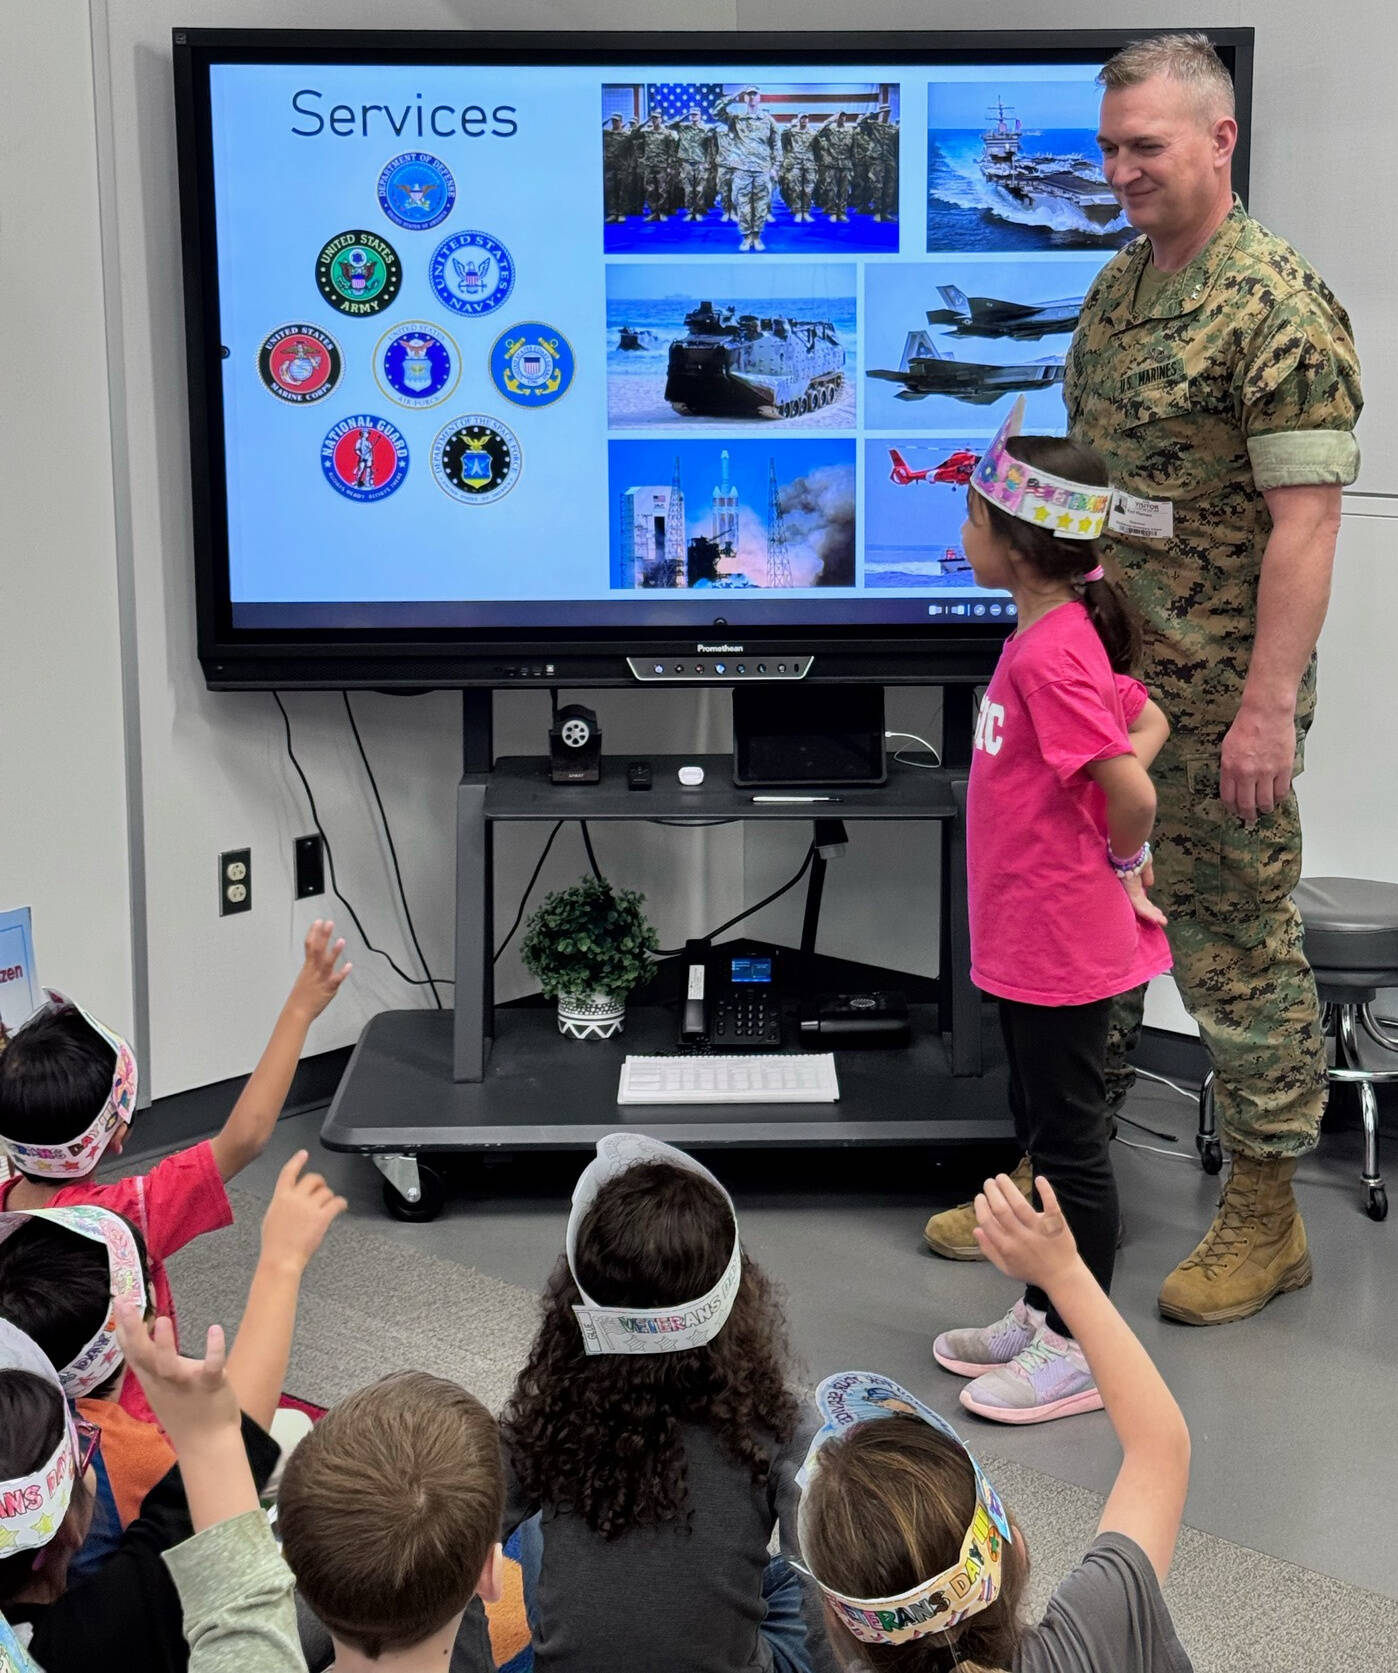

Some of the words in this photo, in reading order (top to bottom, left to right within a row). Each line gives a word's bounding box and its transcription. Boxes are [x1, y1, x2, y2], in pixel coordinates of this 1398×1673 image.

[291, 89, 518, 137] Services
[379, 154, 417, 197] DEPARTMENT
[420, 154, 433, 162] OF
[433, 159, 456, 198] DEFENSE
[320, 234, 355, 263] UNITED
[360, 234, 395, 264] STATES
[434, 235, 471, 289] UNITED
[474, 236, 509, 289] STATES
[340, 300, 380, 313] ARMY
[449, 297, 495, 312] NAVY
[265, 327, 298, 350] UNITED
[302, 326, 334, 350] STATES
[388, 325, 418, 341] UNITED
[420, 325, 445, 341] STATES
[1138, 361, 1178, 386] MARINES
[270, 382, 303, 401] MARINE
[306, 382, 332, 401] CORPS
[322, 416, 374, 457] NATIONAL
[376, 419, 408, 458] GUARD
[433, 422, 460, 474] DEPARTMENT
[491, 421, 513, 442] SPACE
[1135, 501, 1159, 511] VISITOR
[697, 644, 744, 652] Promethean
[68, 1124, 99, 1157] DAY
[618, 1295, 721, 1334] VETERANS
[583, 1320, 598, 1341] GLUE
[826, 1590, 951, 1633] VETERANS
[949, 1537, 985, 1600] DAY
